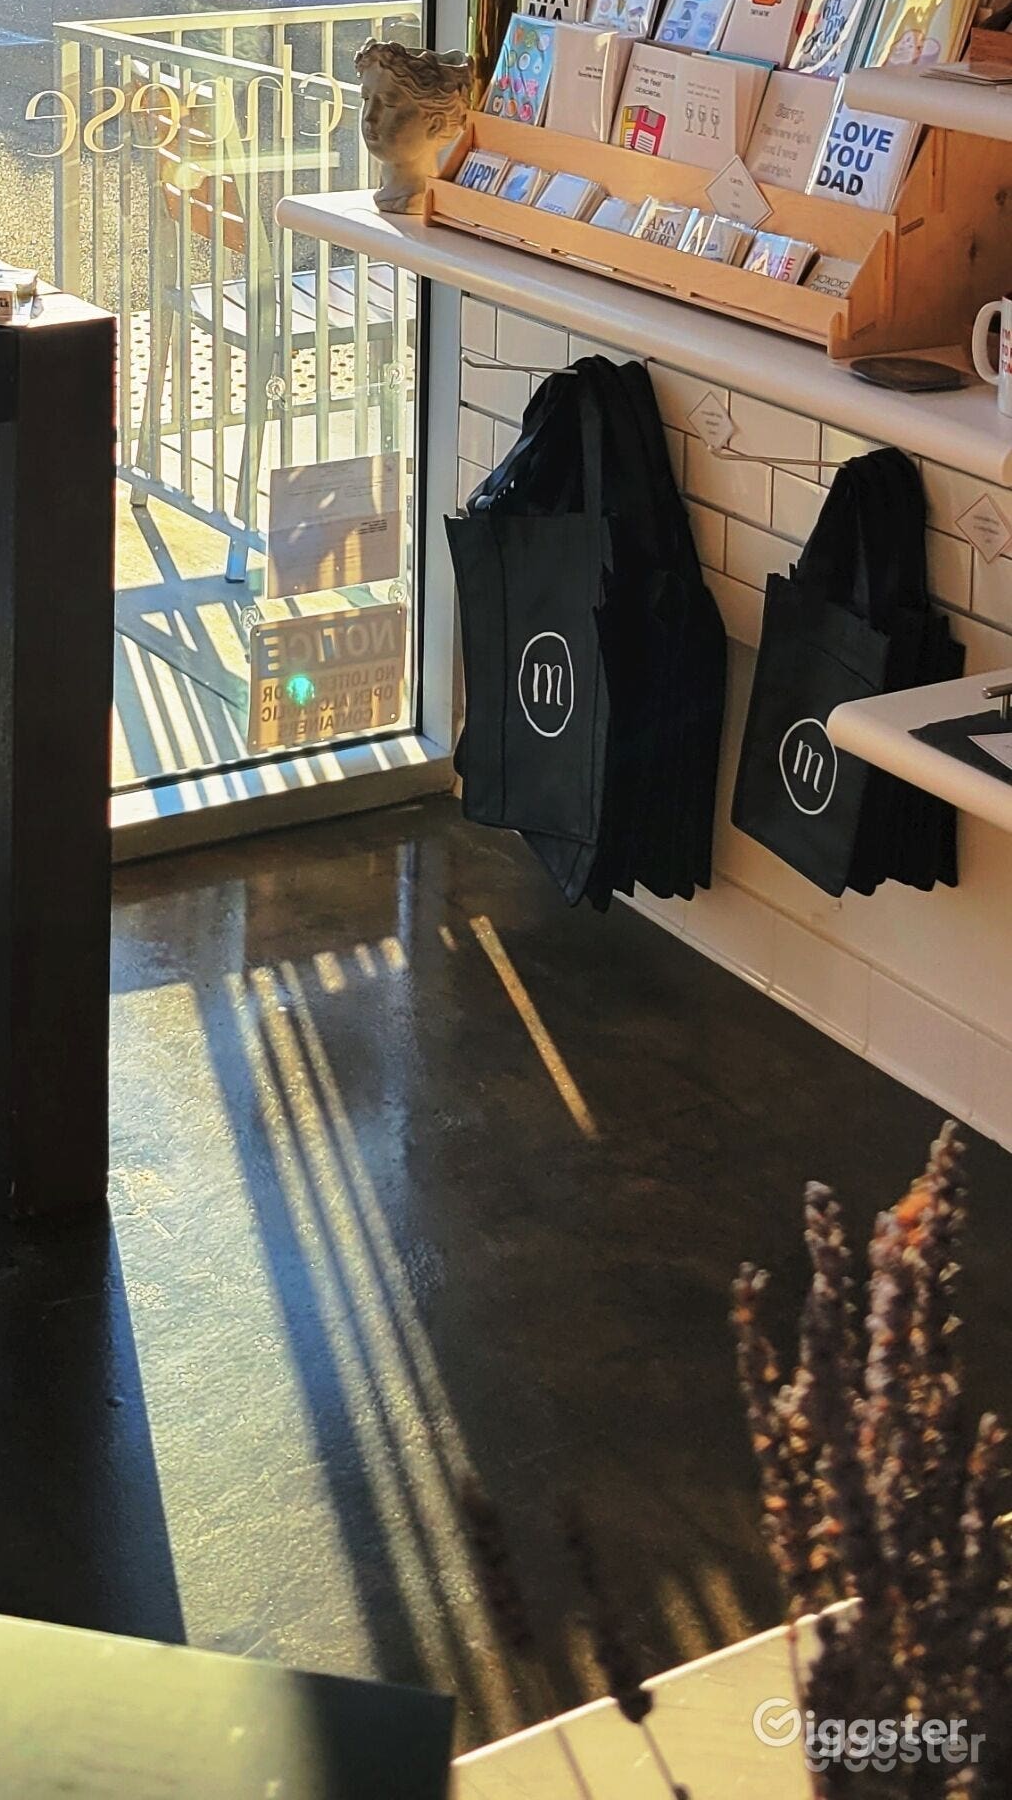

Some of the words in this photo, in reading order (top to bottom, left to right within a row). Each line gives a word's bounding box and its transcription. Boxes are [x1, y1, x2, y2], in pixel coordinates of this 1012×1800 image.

[829, 117, 894, 153] LOVE
[825, 141, 874, 172] YOU
[816, 166, 864, 196] DAD
[533, 661, 564, 708] m
[793, 738, 822, 794] m
